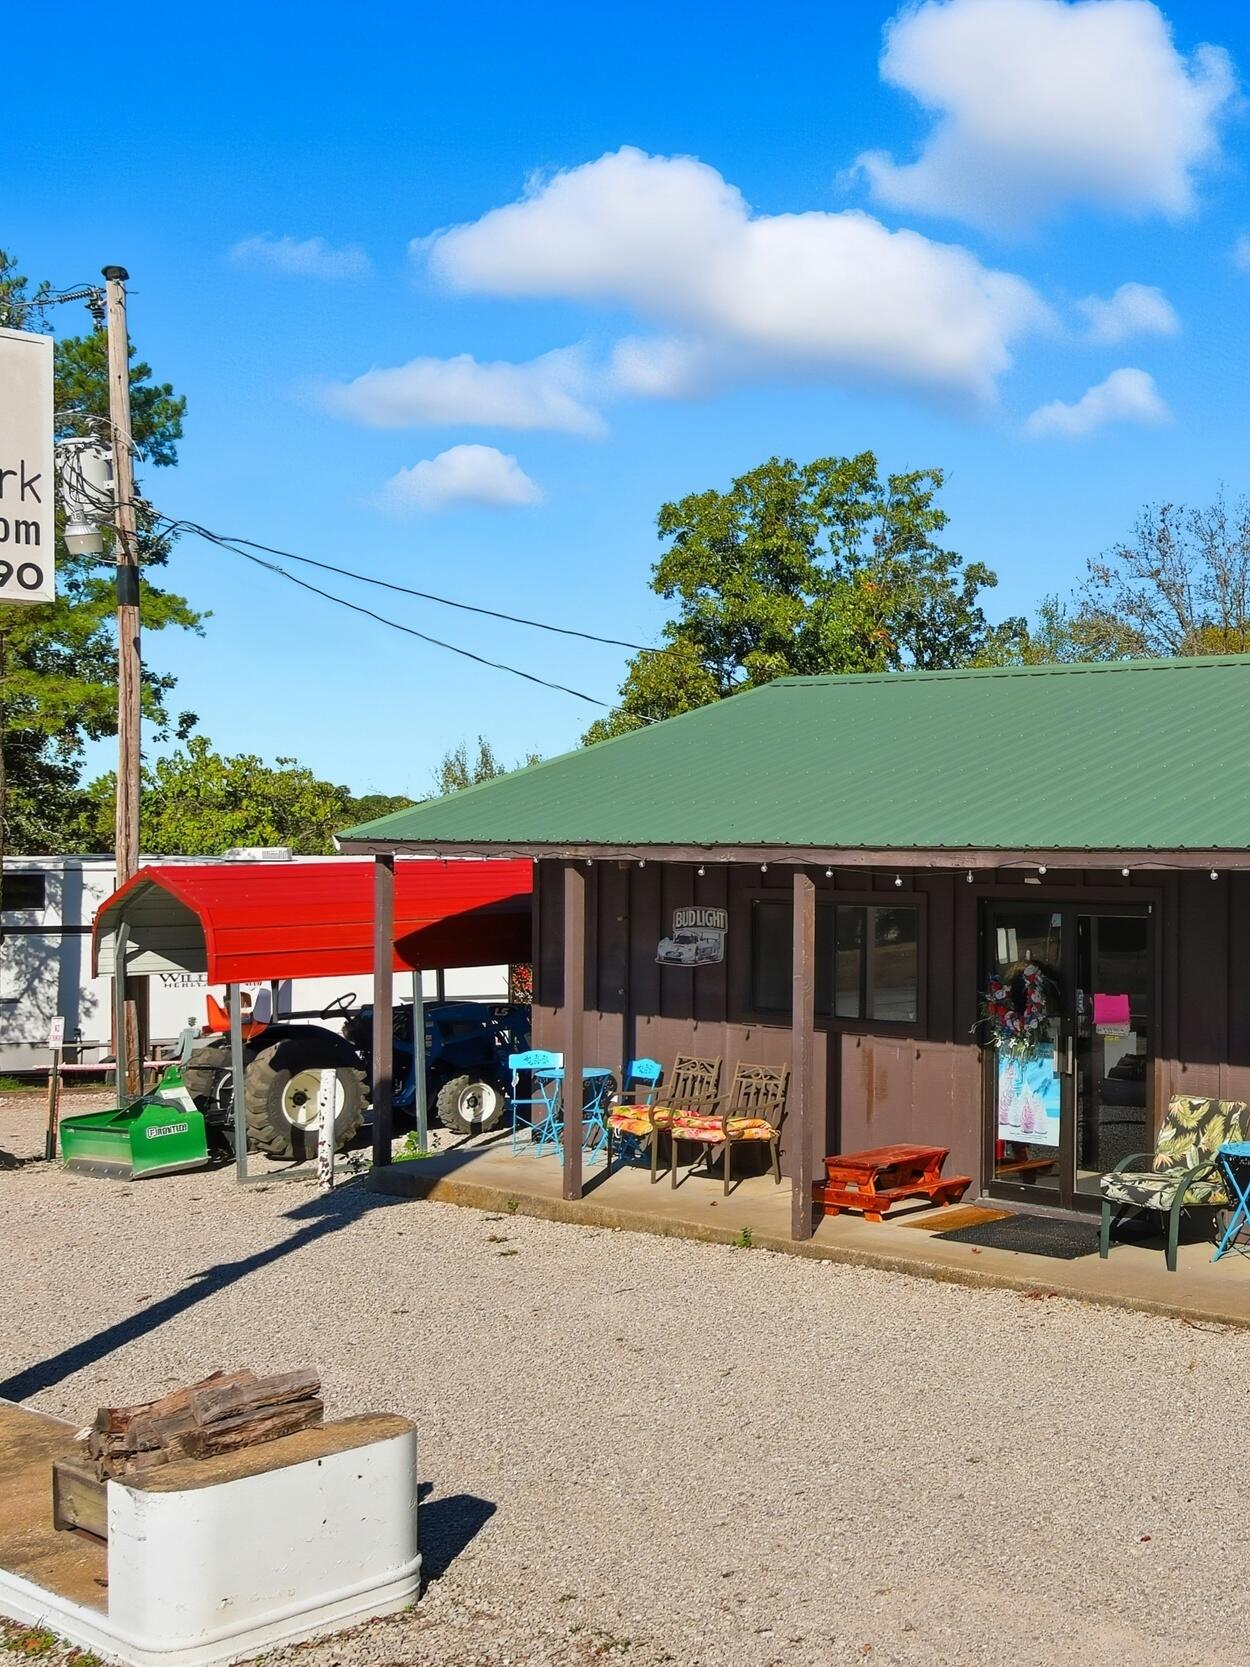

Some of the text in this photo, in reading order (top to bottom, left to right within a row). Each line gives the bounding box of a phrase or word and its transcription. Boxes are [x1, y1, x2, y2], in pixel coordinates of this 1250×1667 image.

[675, 910, 725, 929] BUD LIGHT
[494, 1007, 509, 1016] LS
